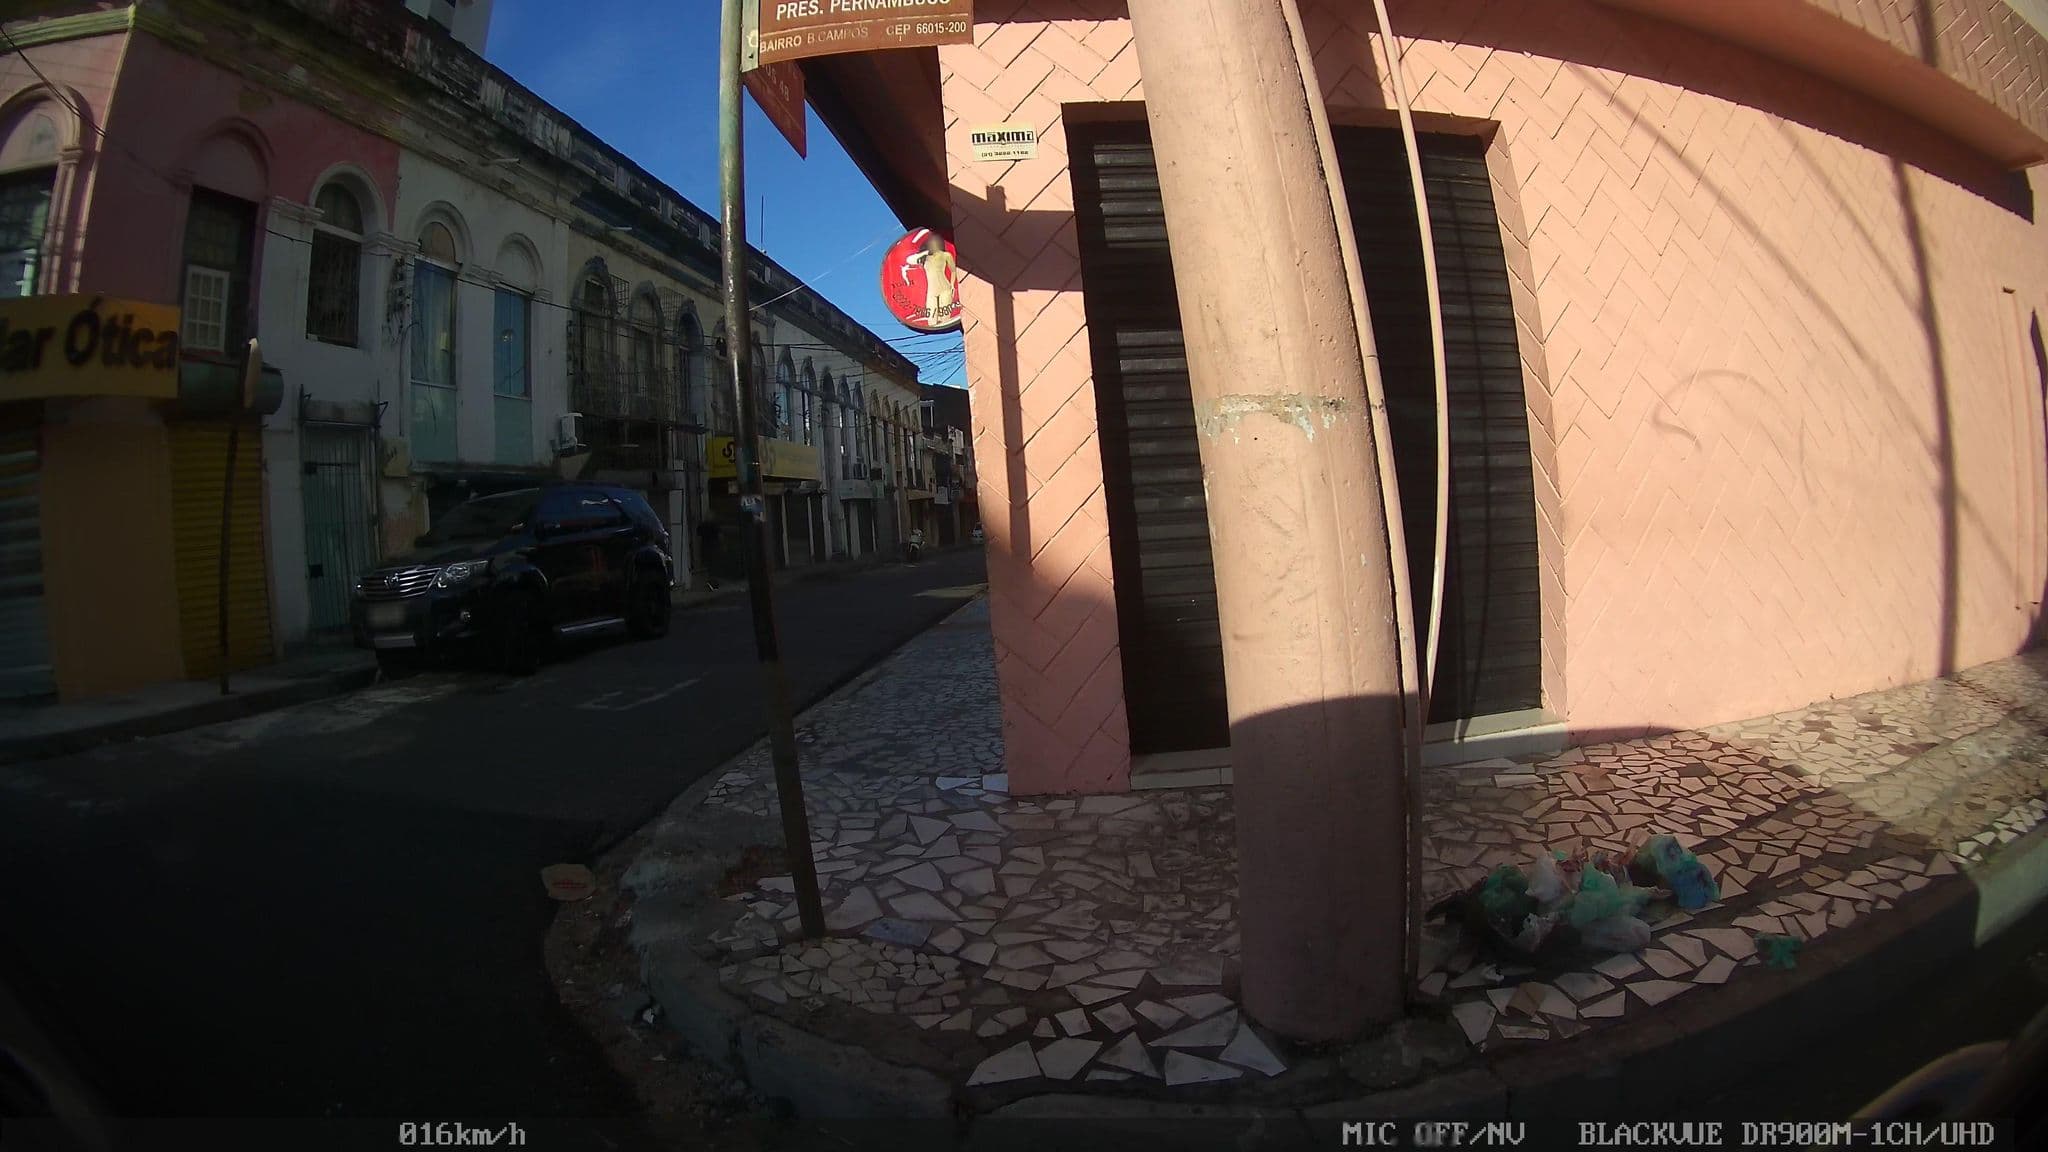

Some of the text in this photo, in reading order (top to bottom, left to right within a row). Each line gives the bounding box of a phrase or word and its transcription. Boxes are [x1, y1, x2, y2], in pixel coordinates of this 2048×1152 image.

[776, 0, 824, 20] PRES.
[760, 35, 802, 53] BAIRRO
[886, 24, 911, 36] CEP
[916, 21, 967, 34] 66015-200
[64, 297, 178, 369] Ótica
